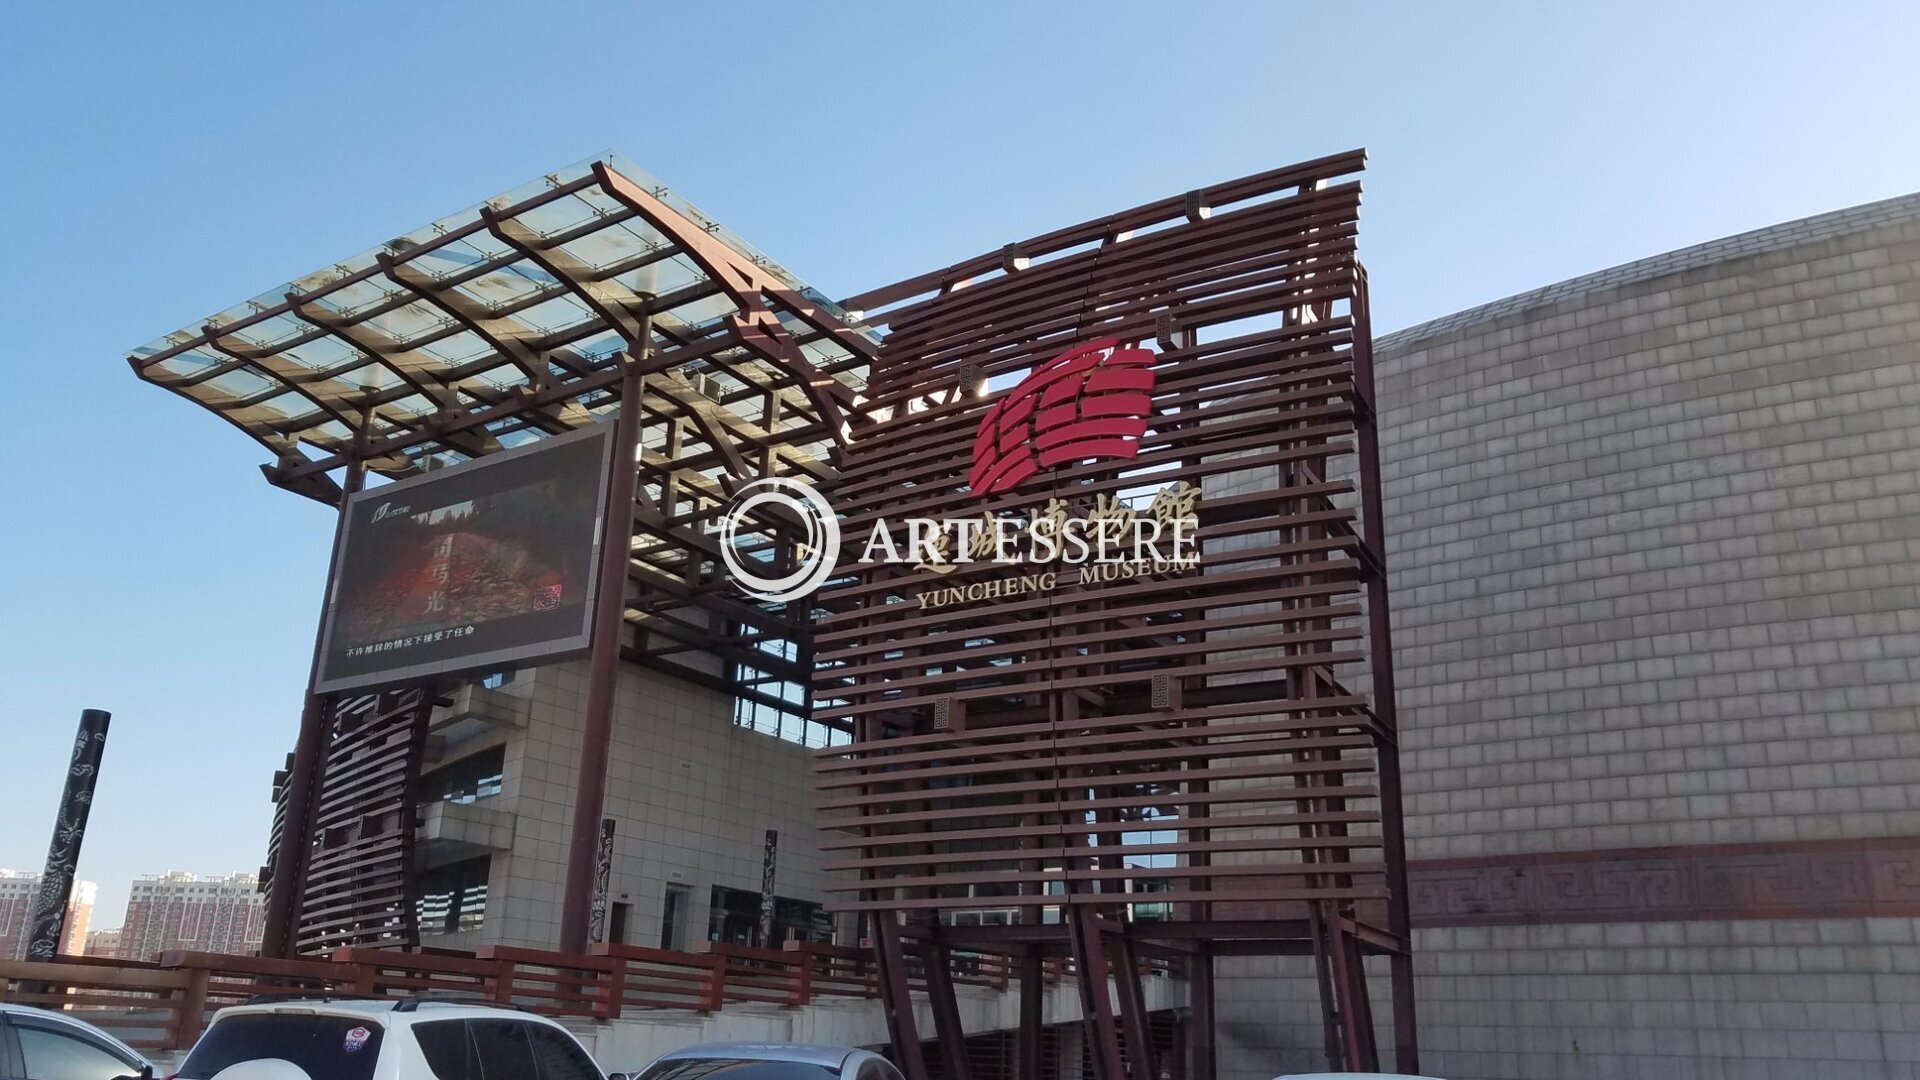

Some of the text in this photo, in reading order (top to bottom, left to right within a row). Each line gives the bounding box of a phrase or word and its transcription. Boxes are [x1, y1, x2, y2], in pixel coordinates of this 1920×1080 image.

[916, 551, 1197, 609] YUNCHENG MUSEUM
[346, 625, 475, 657] 不许推辞的情况下接受了任命
